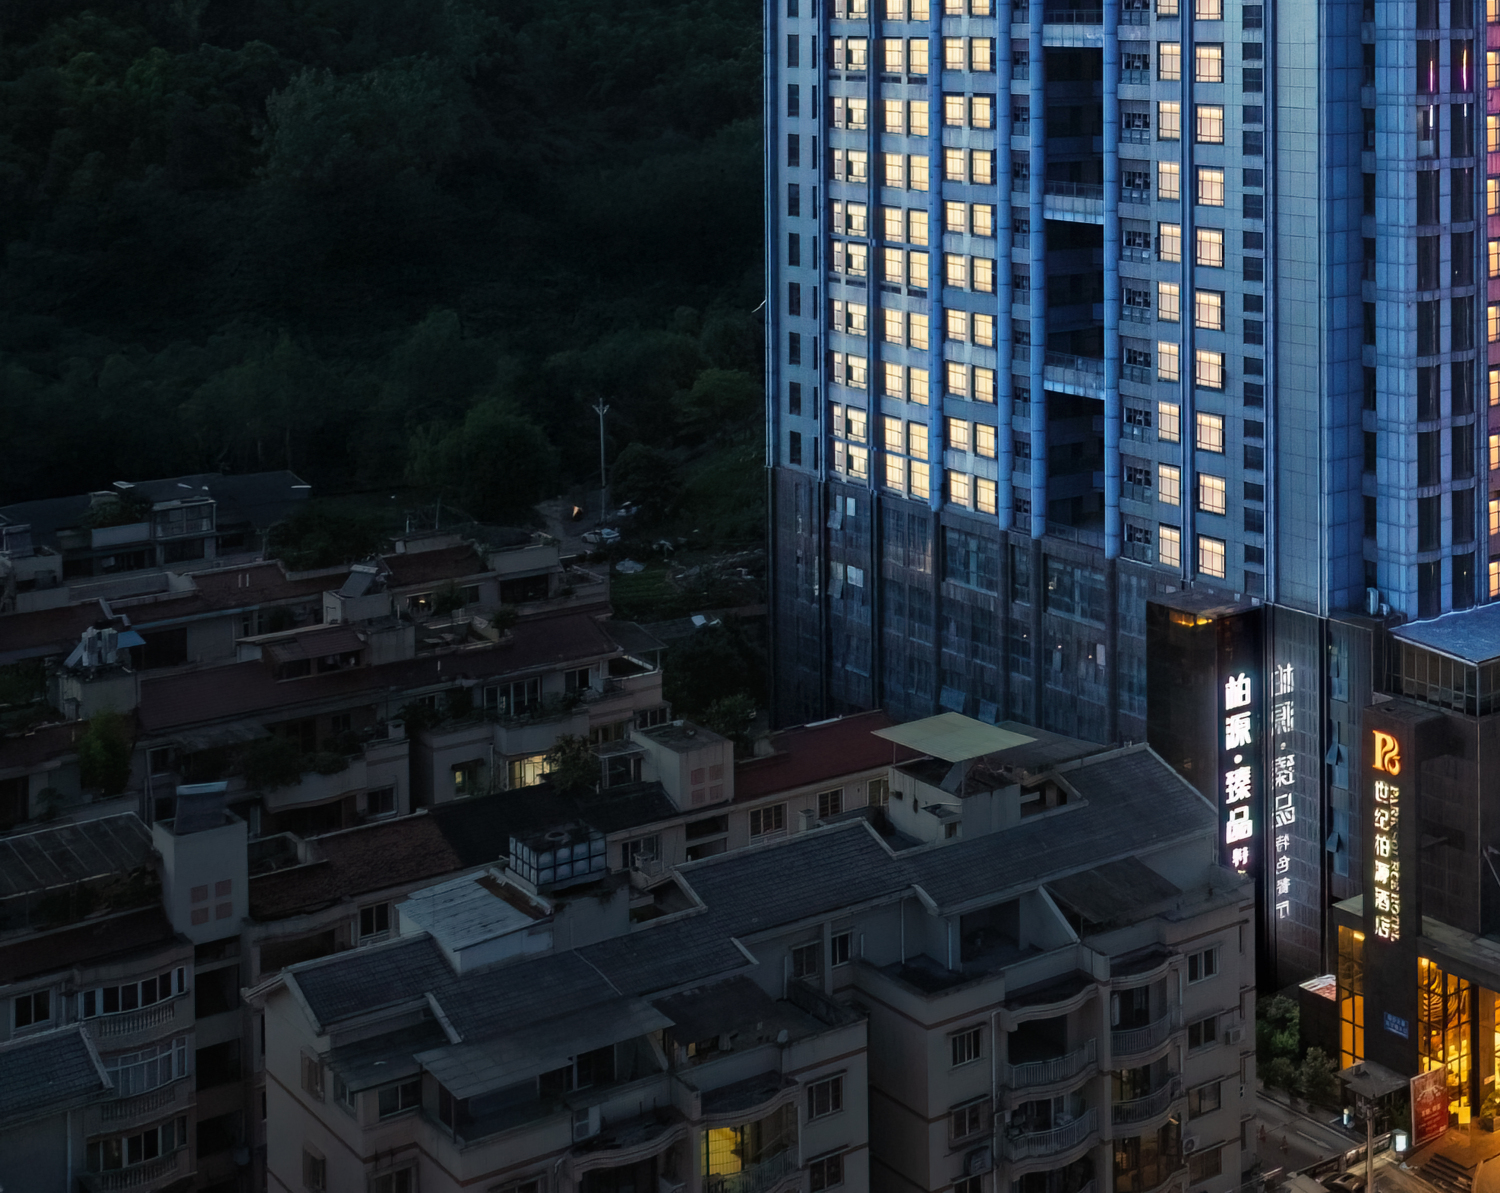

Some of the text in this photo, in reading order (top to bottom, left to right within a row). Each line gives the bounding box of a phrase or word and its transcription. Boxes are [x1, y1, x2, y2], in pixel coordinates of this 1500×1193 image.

[1225, 672, 1253, 844] 柏源·臻品
[1390, 785, 1400, 829] PARK
[1374, 780, 1390, 939] 世纪柏源酒店
